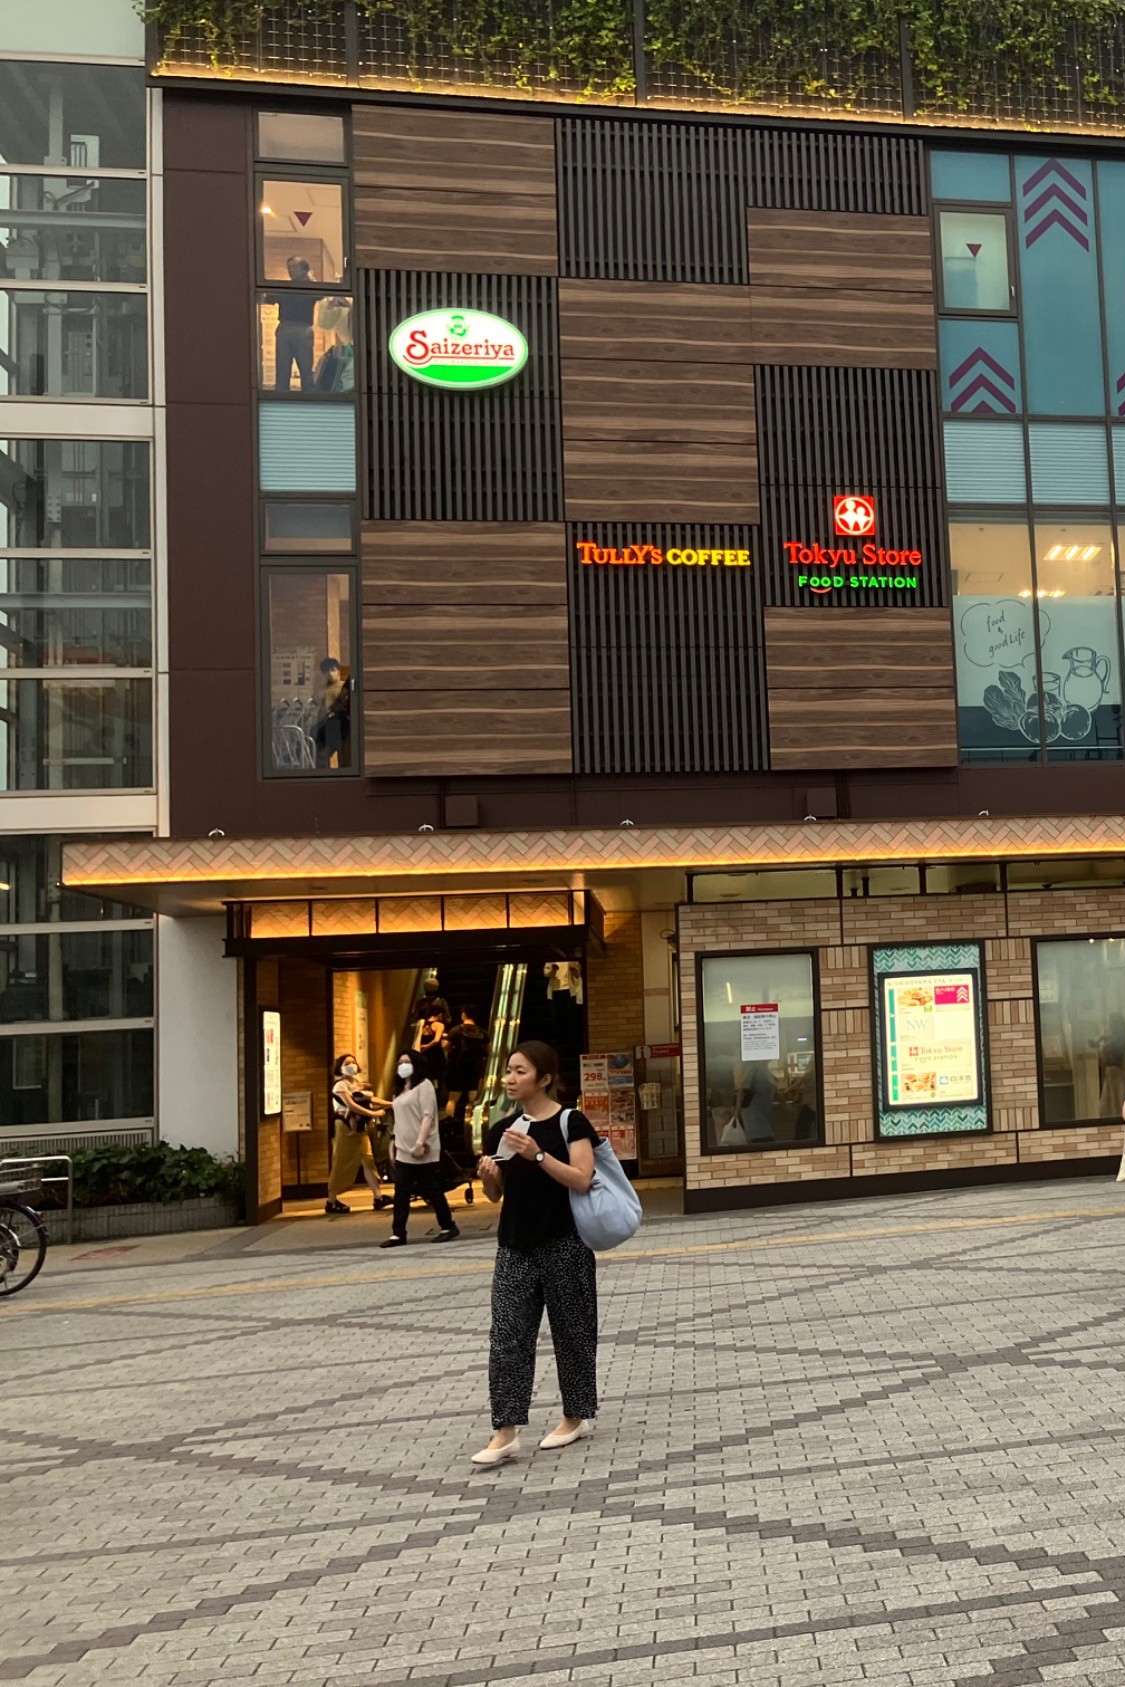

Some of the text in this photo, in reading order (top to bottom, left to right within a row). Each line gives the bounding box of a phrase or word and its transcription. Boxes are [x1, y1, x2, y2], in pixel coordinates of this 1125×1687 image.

[406, 330, 515, 360] Saizeriya
[666, 548, 750, 566] COFFEE
[784, 542, 922, 567] Tokyu Store
[798, 575, 917, 589] FOOD STATION
[986, 609, 1006, 633] food
[988, 634, 1009, 659] good
[584, 1073, 603, 1081] 298
